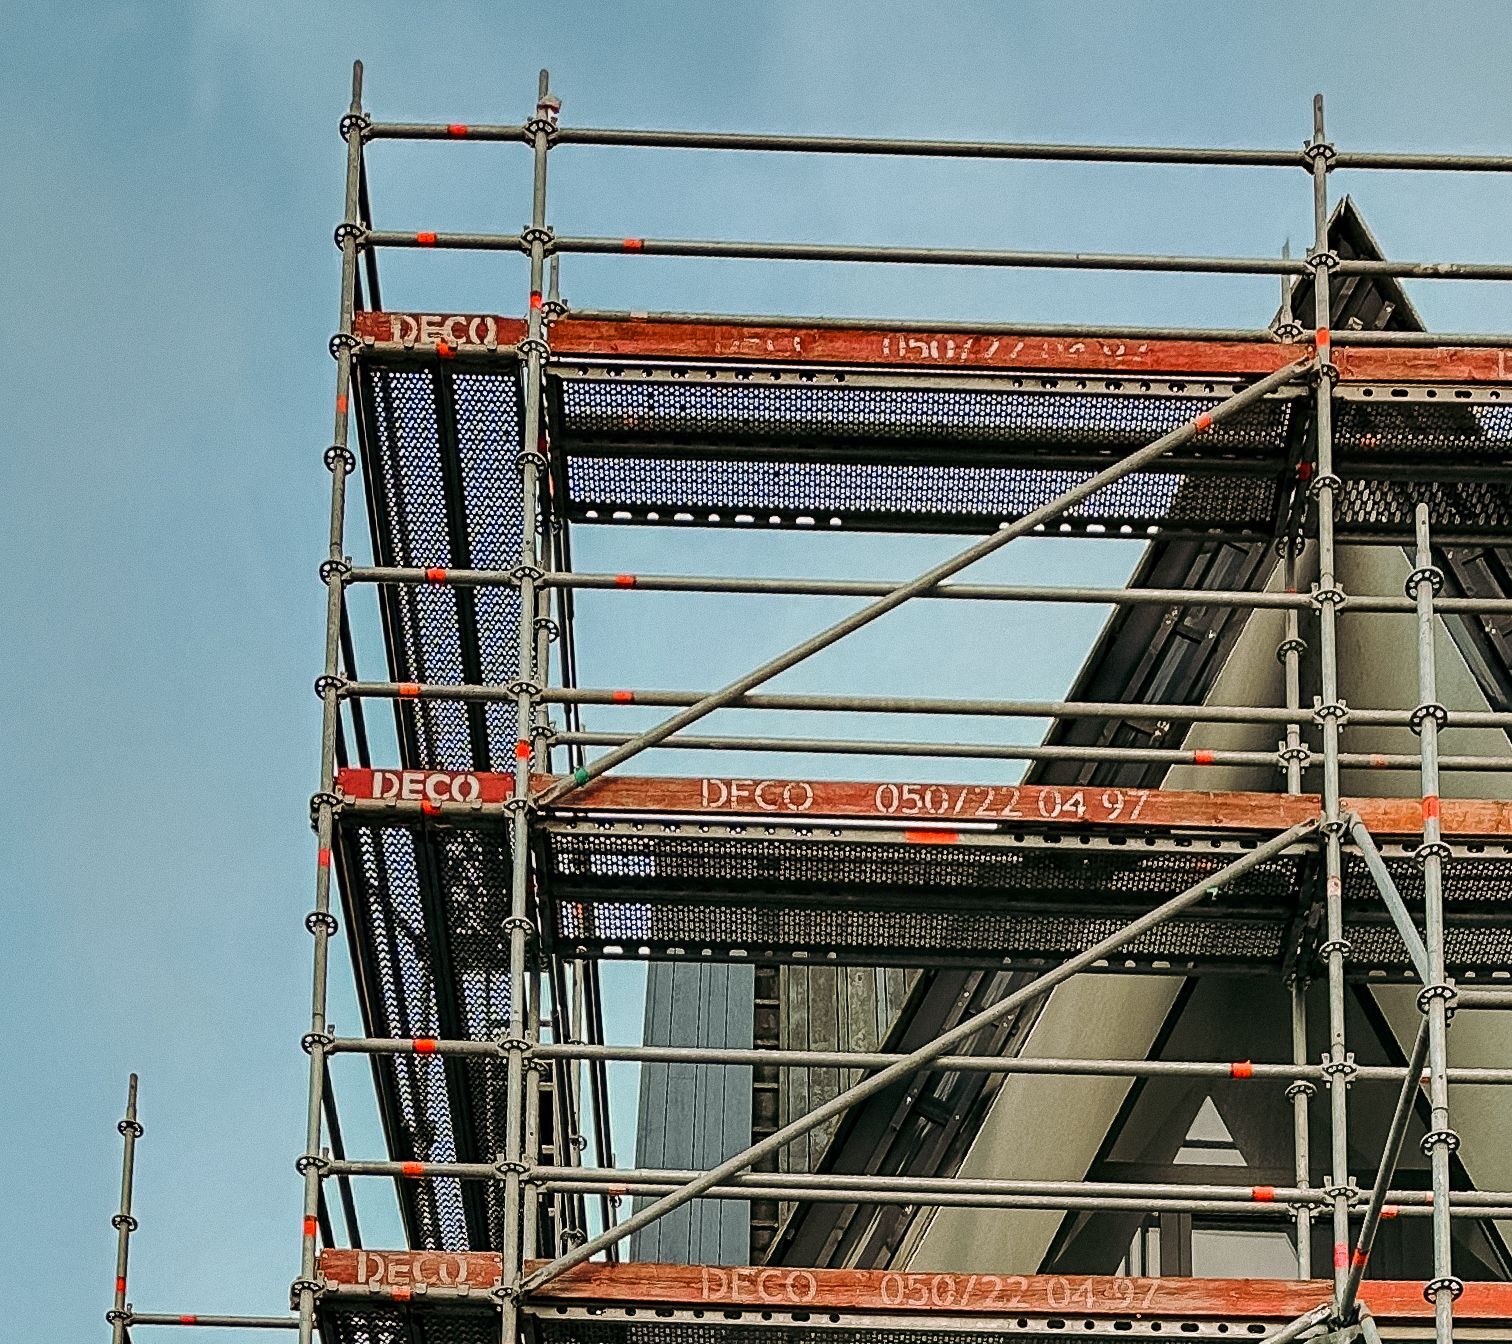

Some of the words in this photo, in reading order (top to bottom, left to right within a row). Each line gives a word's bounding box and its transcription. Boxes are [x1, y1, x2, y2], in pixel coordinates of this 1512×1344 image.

[391, 314, 497, 345] DECO
[372, 772, 480, 802] DECO
[701, 779, 814, 812] DECO
[875, 784, 1023, 817] 050/22
[1038, 787, 1087, 819] 04
[1102, 790, 1150, 820] 97
[357, 1251, 467, 1285] DECO
[701, 1268, 818, 1302] DECO
[880, 1274, 1030, 1309] 050/22
[1046, 1278, 1095, 1309] 04
